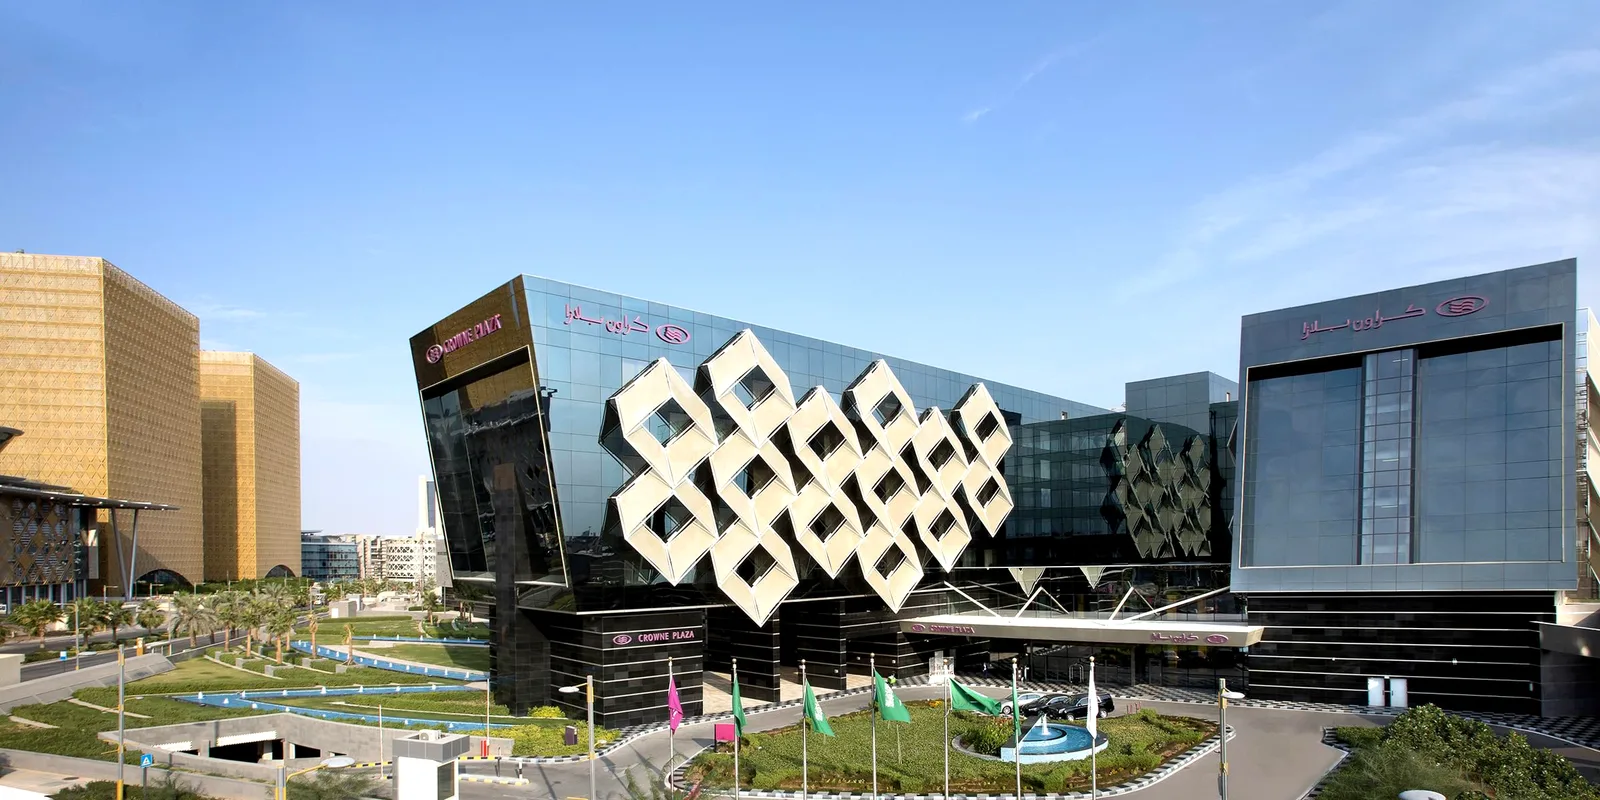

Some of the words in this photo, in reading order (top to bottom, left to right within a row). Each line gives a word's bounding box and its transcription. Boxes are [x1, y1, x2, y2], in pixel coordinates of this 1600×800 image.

[564, 304, 604, 325] بلازا
[1353, 303, 1426, 331] كراون
[474, 313, 502, 340] PLAZA
[606, 315, 649, 335] كراون
[1301, 320, 1350, 340] بلازا
[638, 632, 669, 642] CROWNE
[672, 630, 695, 640] PLAZA
